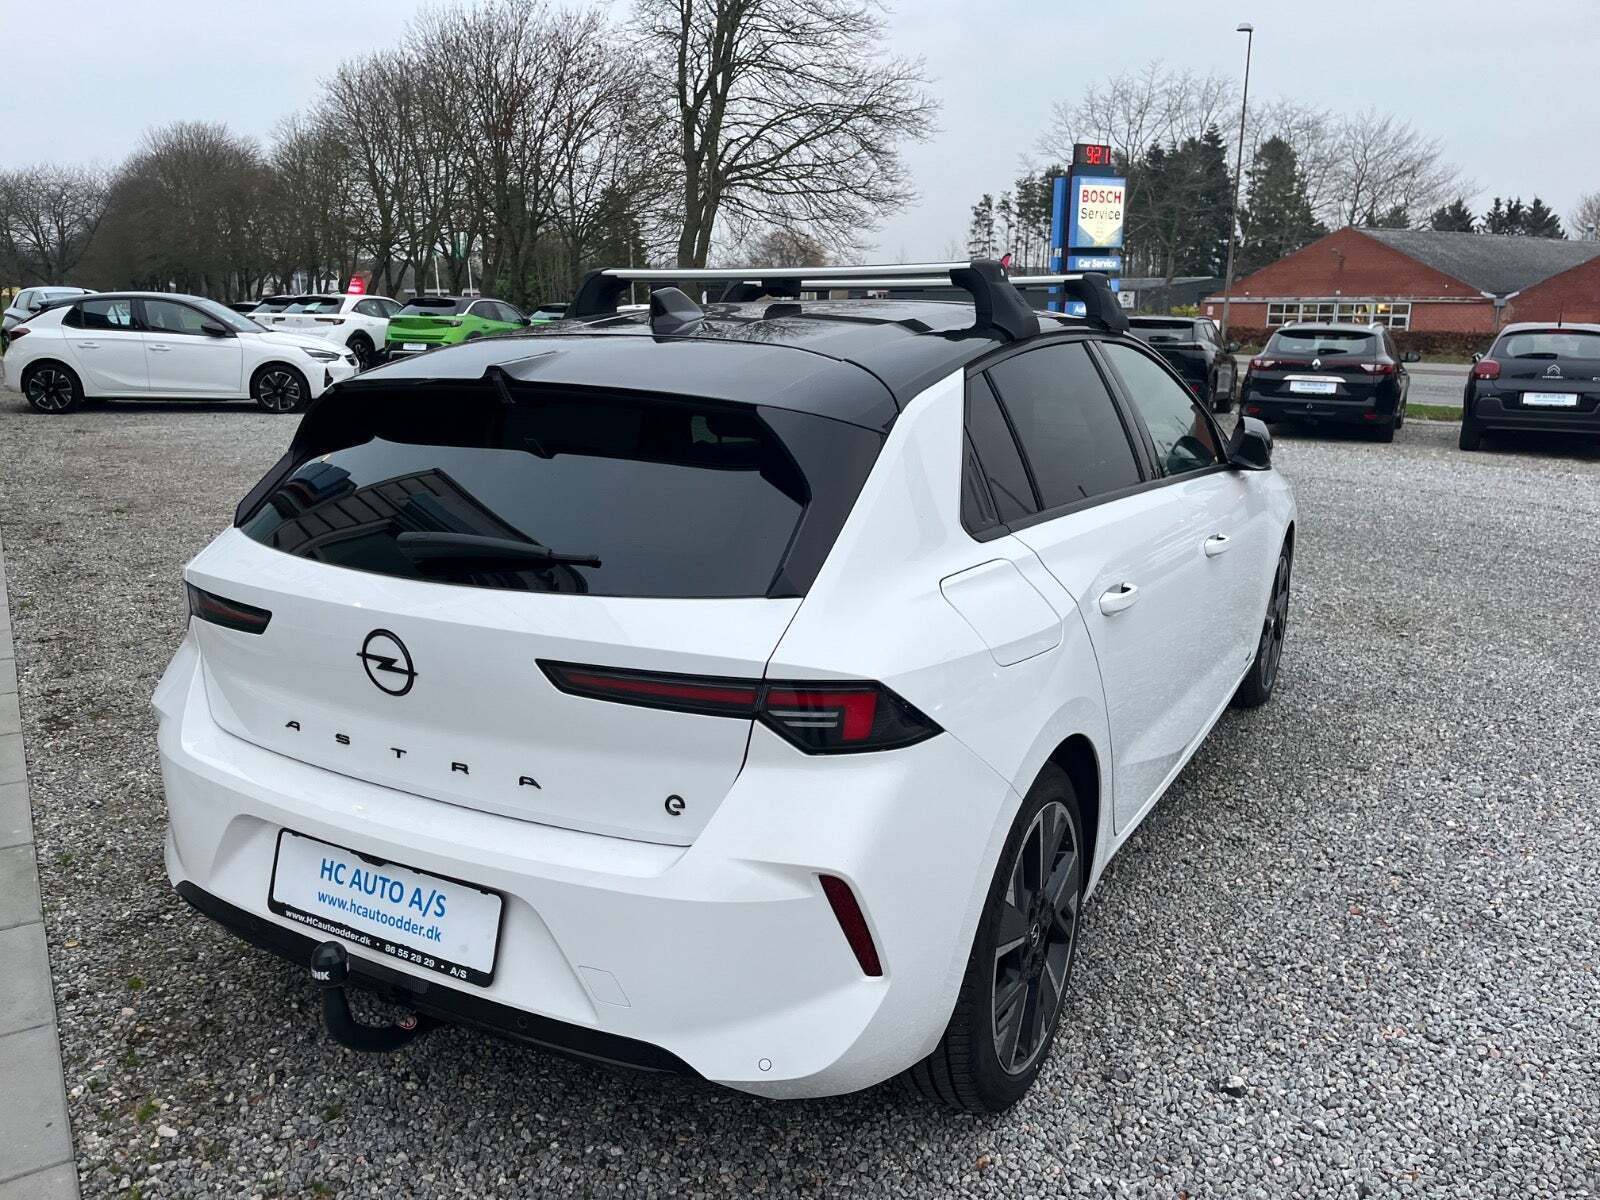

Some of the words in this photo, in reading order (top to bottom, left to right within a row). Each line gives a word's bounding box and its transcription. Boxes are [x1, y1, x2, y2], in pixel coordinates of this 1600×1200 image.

[1080, 207, 1121, 220] Service
[1082, 189, 1122, 204] BOSCH
[1078, 259, 1091, 268] Car
[1092, 259, 1117, 268] Service
[284, 719, 542, 790] ASTRA
[320, 858, 346, 885] HC
[349, 868, 404, 903] AUTO
[408, 887, 446, 918] A/S
[318, 891, 442, 942] www.hcautoodder.dk
[285, 909, 371, 946] www.HCautoodder.dk
[385, 944, 396, 955] 86
[397, 948, 409, 959] 55
[410, 953, 422, 964] 28
[423, 957, 435, 968] 29
[449, 966, 467, 979] A/S
